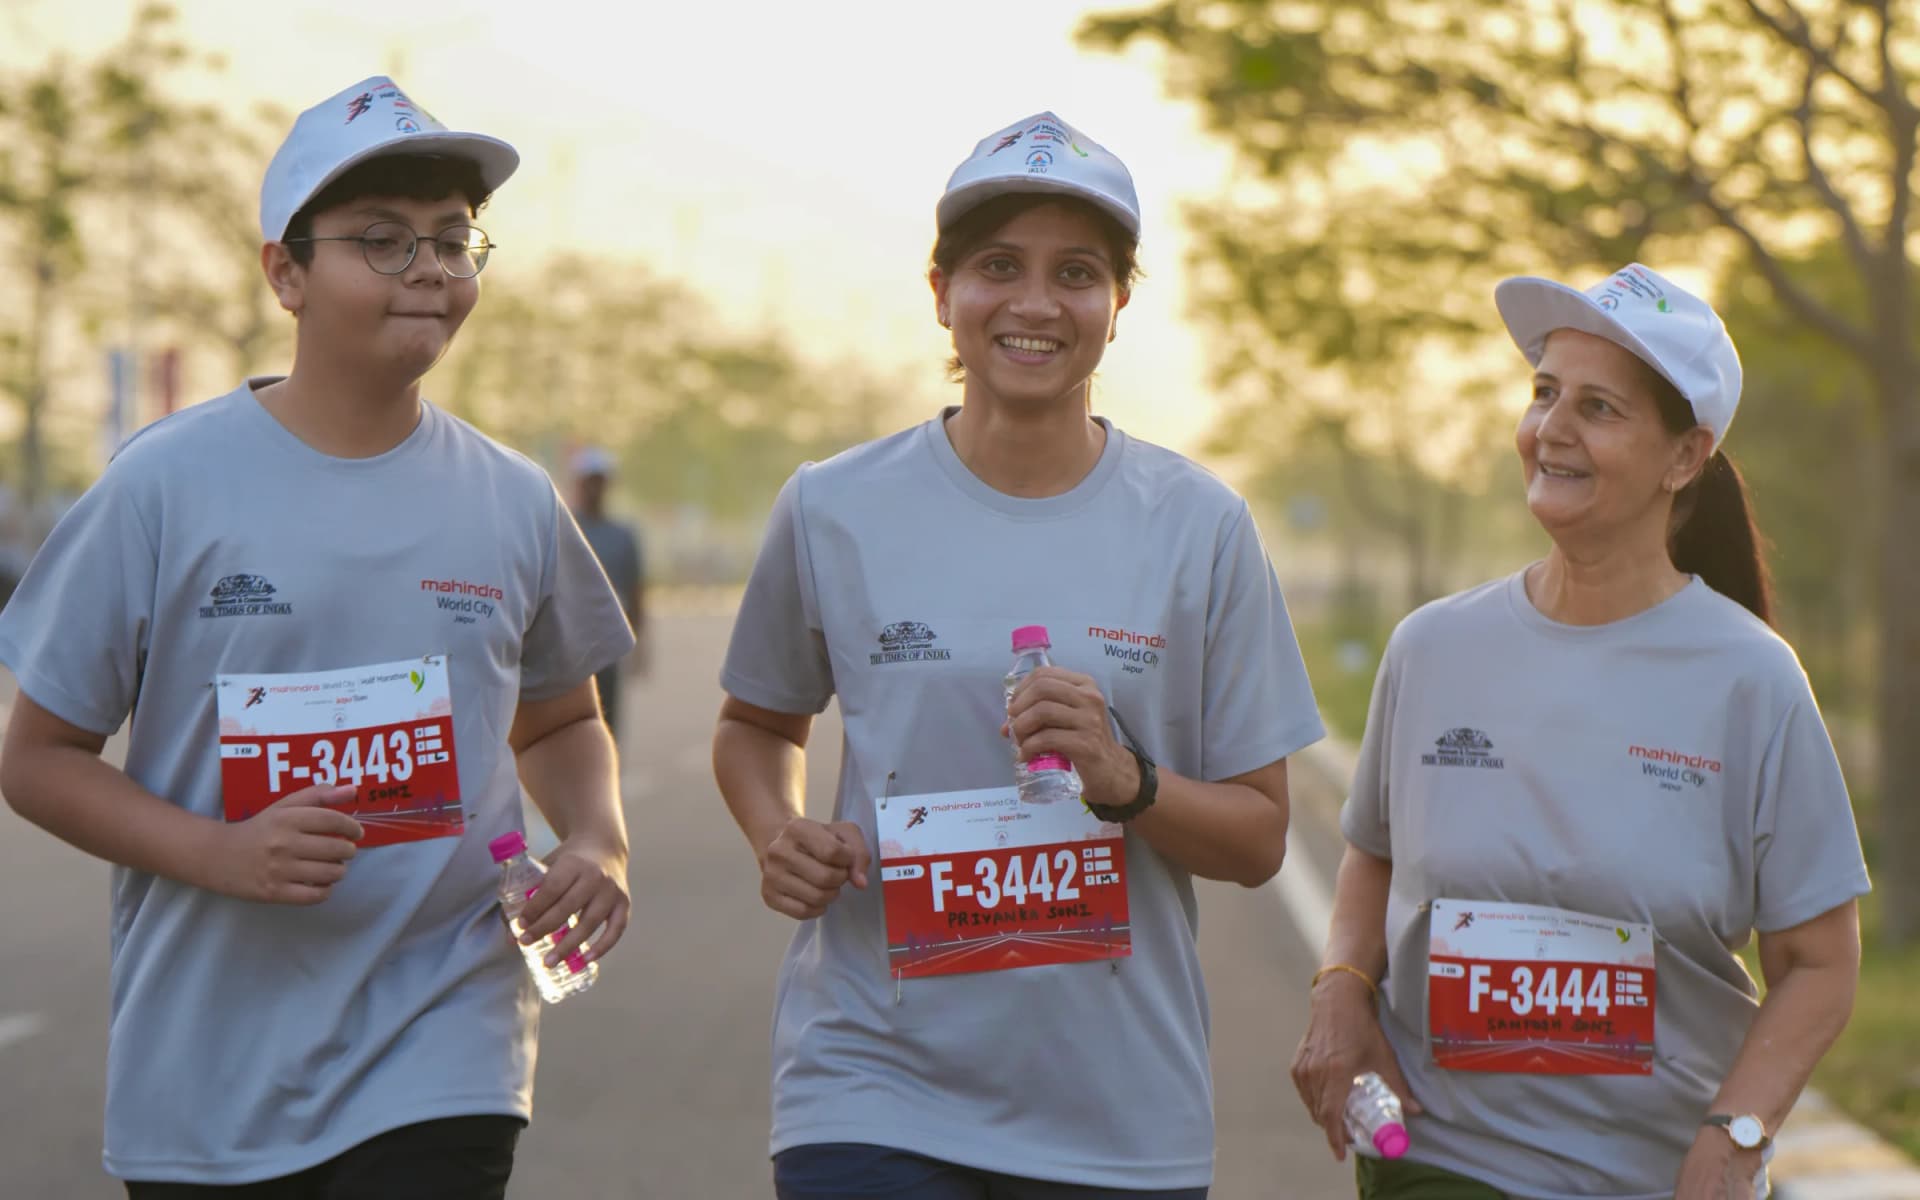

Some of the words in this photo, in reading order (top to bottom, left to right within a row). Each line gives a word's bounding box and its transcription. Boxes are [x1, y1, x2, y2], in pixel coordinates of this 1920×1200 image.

[421, 579, 504, 600] mahindra
[218, 605, 244, 616] TIMES
[246, 604, 260, 616] OF
[263, 602, 292, 615] INDIA
[436, 596, 472, 612] World
[473, 600, 494, 618] City
[454, 614, 476, 624] Jaipur
[870, 654, 883, 665] THE
[885, 652, 907, 664] TIMES
[908, 650, 920, 662] OF
[923, 650, 951, 660] INDIA
[1104, 643, 1140, 662] World
[1122, 662, 1144, 674] Jaipur
[266, 730, 413, 793] F-3443
[1628, 745, 1721, 772] mahindra
[1642, 762, 1679, 780] World
[1681, 768, 1705, 788] City
[932, 801, 982, 812] mahindra
[984, 800, 1004, 808] World
[1004, 798, 1018, 808] City
[903, 868, 915, 876] KM
[930, 849, 1080, 912] F-3442
[1047, 904, 1093, 919] SONI
[1468, 964, 1610, 1016] F-3444
